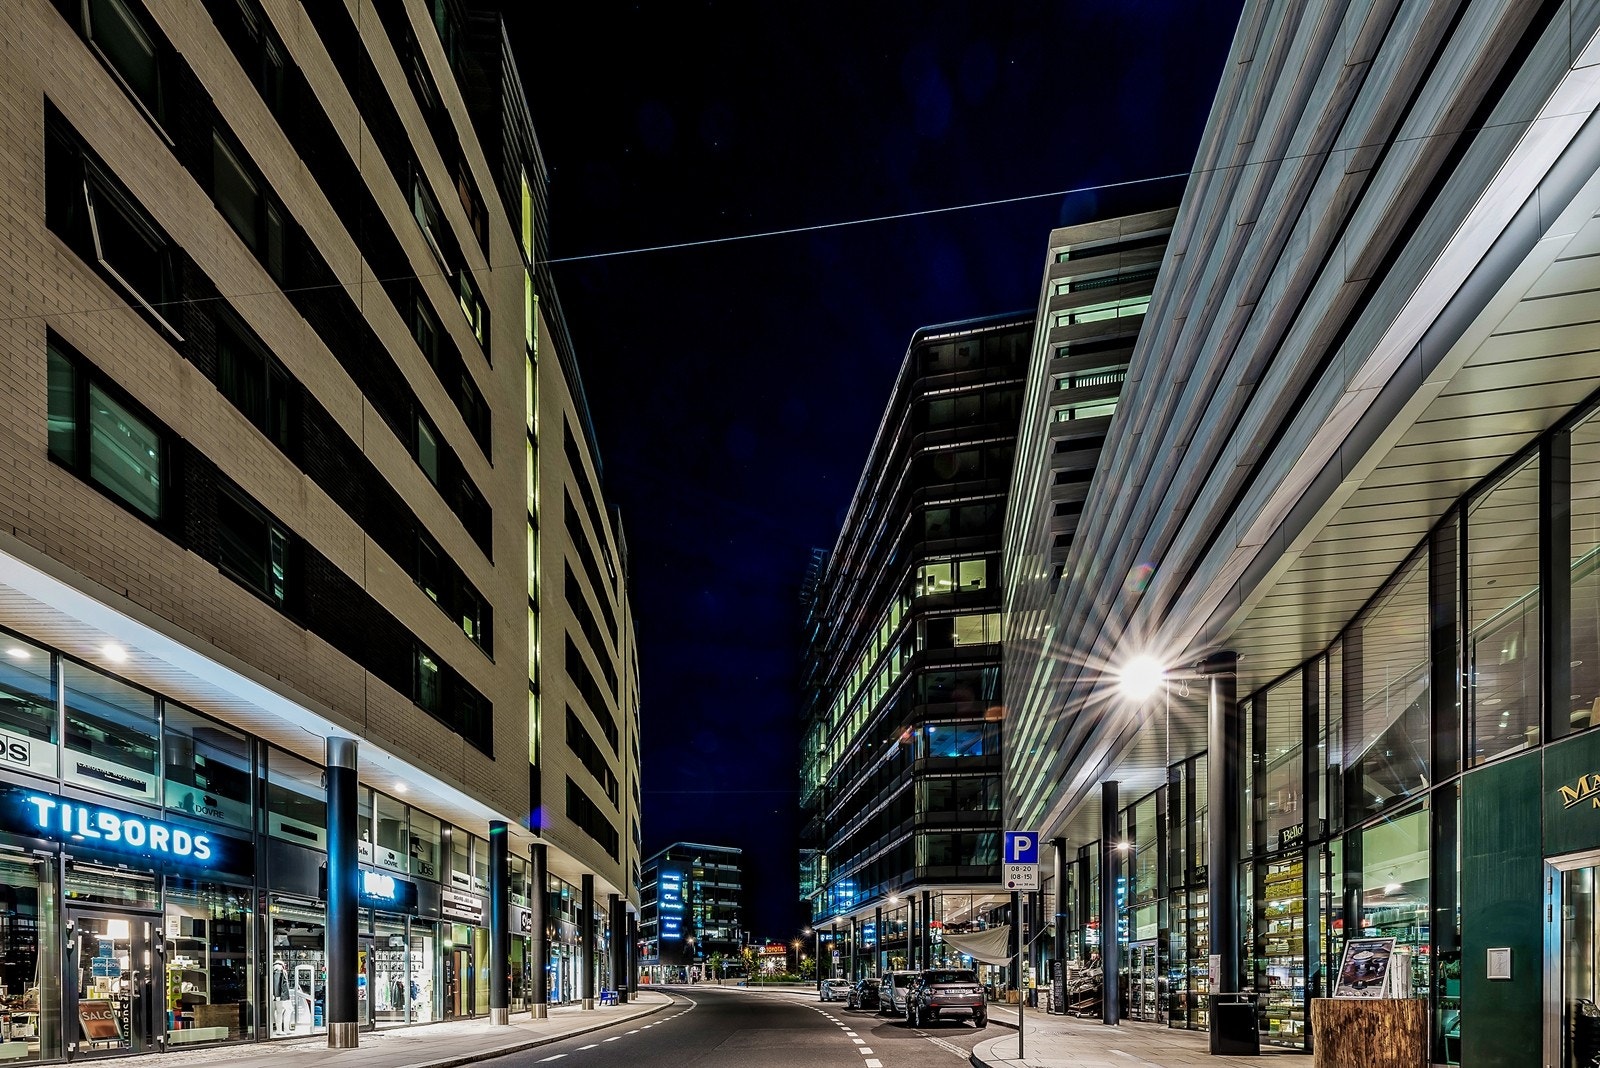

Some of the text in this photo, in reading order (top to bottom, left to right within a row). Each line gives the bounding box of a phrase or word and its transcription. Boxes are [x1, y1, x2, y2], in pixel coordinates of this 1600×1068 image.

[195, 804, 225, 820] DOVRE
[30, 796, 211, 860] TILBORDS
[1013, 835, 1032, 861] P
[1010, 873, 1033, 881] (08-15)
[82, 1010, 113, 1021] SALG
